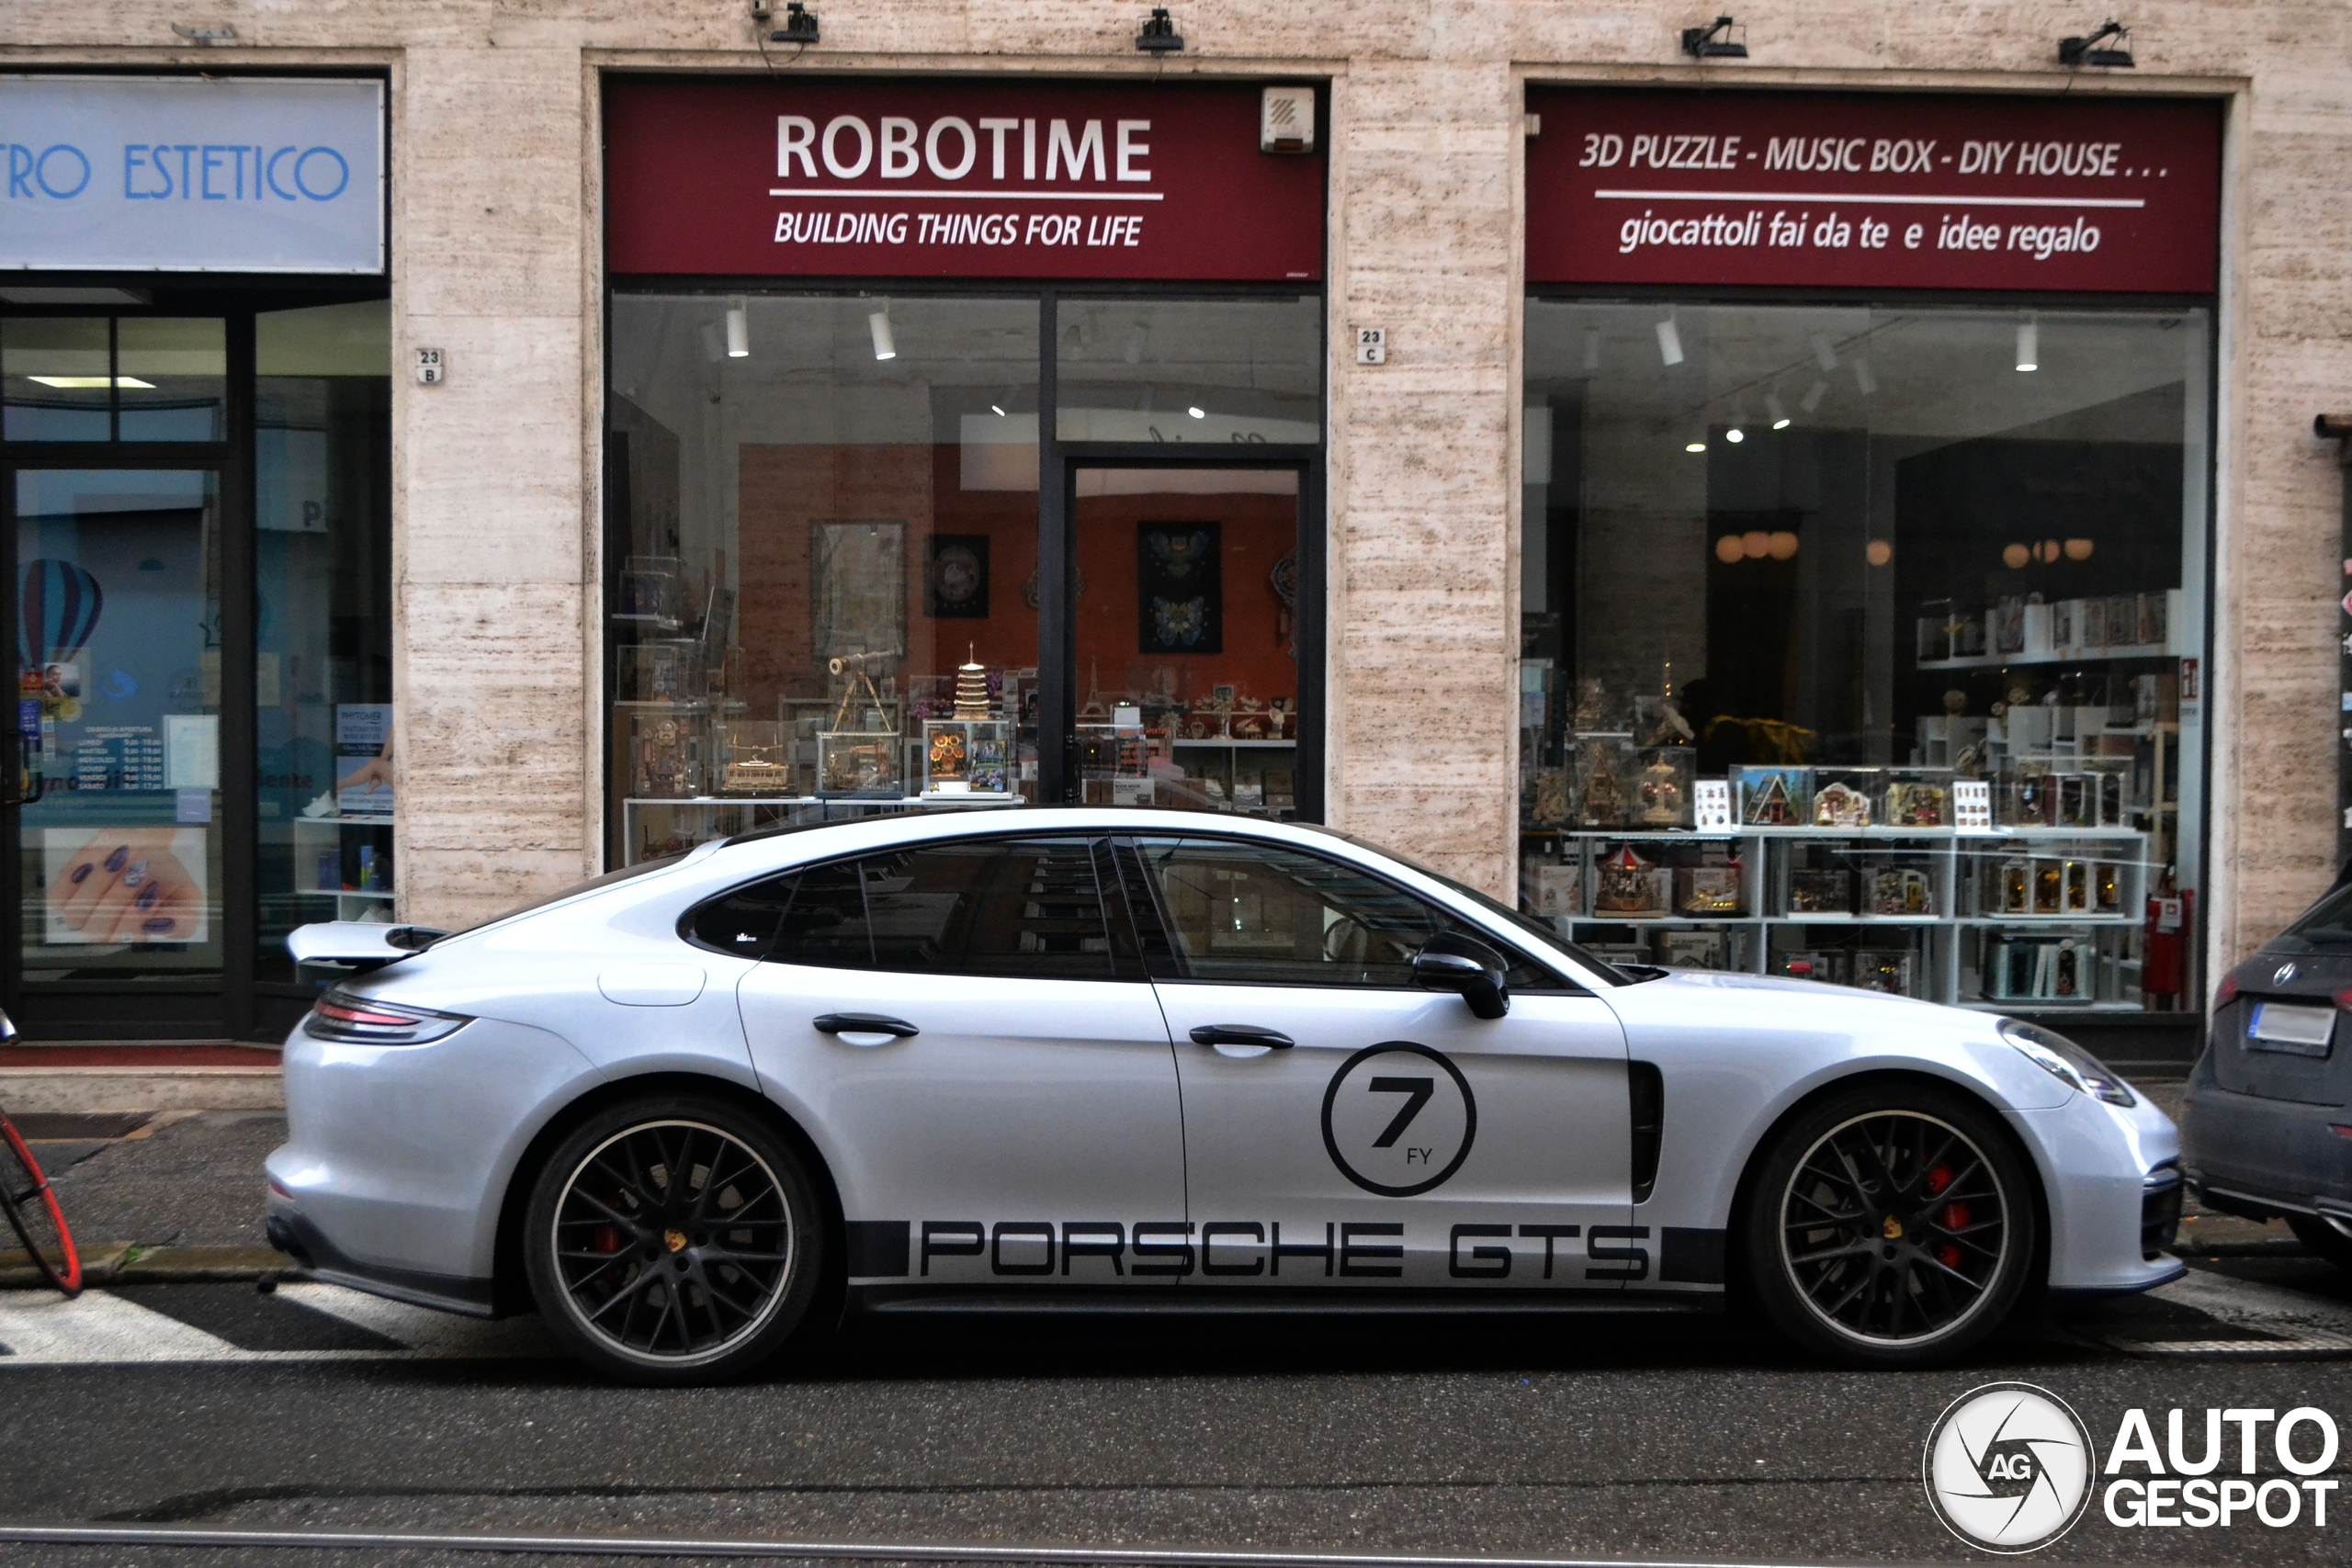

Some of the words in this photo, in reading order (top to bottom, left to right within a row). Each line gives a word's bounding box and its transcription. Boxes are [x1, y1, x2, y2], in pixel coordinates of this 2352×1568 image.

[776, 115, 1152, 180] ROBOTIME
[1578, 133, 1623, 168] 3D
[1629, 135, 1741, 171] PUZZLE
[1764, 137, 1866, 174] MUSIC
[1869, 139, 1936, 175] BOX
[1958, 140, 2013, 175] DIY
[0, 143, 91, 199] RO
[124, 143, 349, 202] ESTETICO
[774, 211, 907, 245] BUILDING
[917, 212, 1017, 246] THINGS
[1025, 214, 1080, 247] FOR
[1088, 215, 1143, 248] LIFE
[1620, 209, 1763, 254] giocattoli
[1770, 211, 1809, 248] fai
[1814, 212, 1850, 249] da
[1860, 217, 1888, 250] te
[1905, 225, 1923, 251] e
[1937, 215, 2000, 252] idee
[2007, 217, 2100, 261] regalo
[1362, 331, 1380, 343] 23
[1366, 349, 1375, 361] C
[421, 352, 438, 364] 23
[425, 369, 435, 382] B
[1368, 1077, 1435, 1148] 7
[1406, 1148, 1433, 1166] FY
[920, 1220, 1404, 1278] PORSCHE
[1449, 1224, 1649, 1281] GTS
